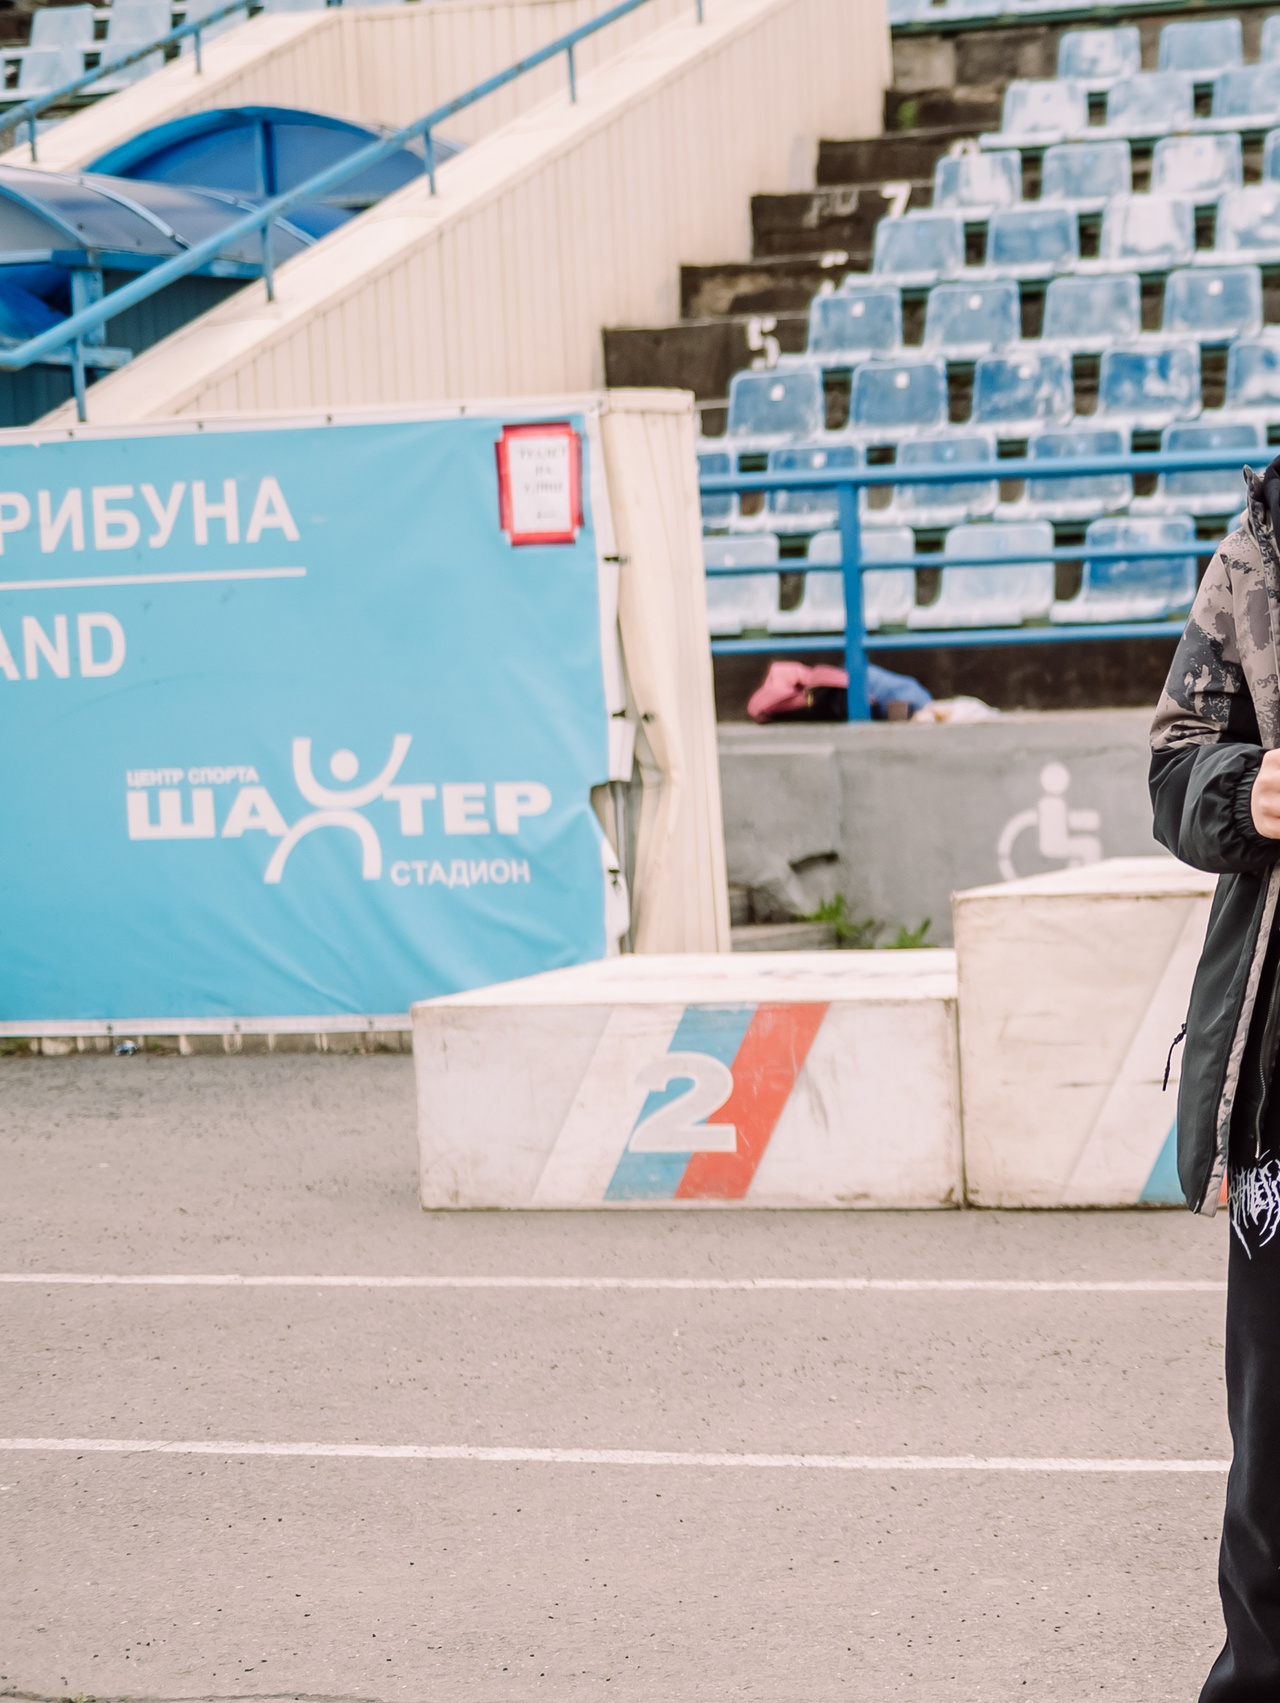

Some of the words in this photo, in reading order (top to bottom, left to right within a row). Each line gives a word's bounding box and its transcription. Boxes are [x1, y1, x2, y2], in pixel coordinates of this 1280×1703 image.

[126, 767, 184, 788] ЦЕНТР
[187, 765, 260, 784] СПОРТА
[390, 858, 531, 889] СТАДИОН
[629, 1051, 737, 1152] 2
